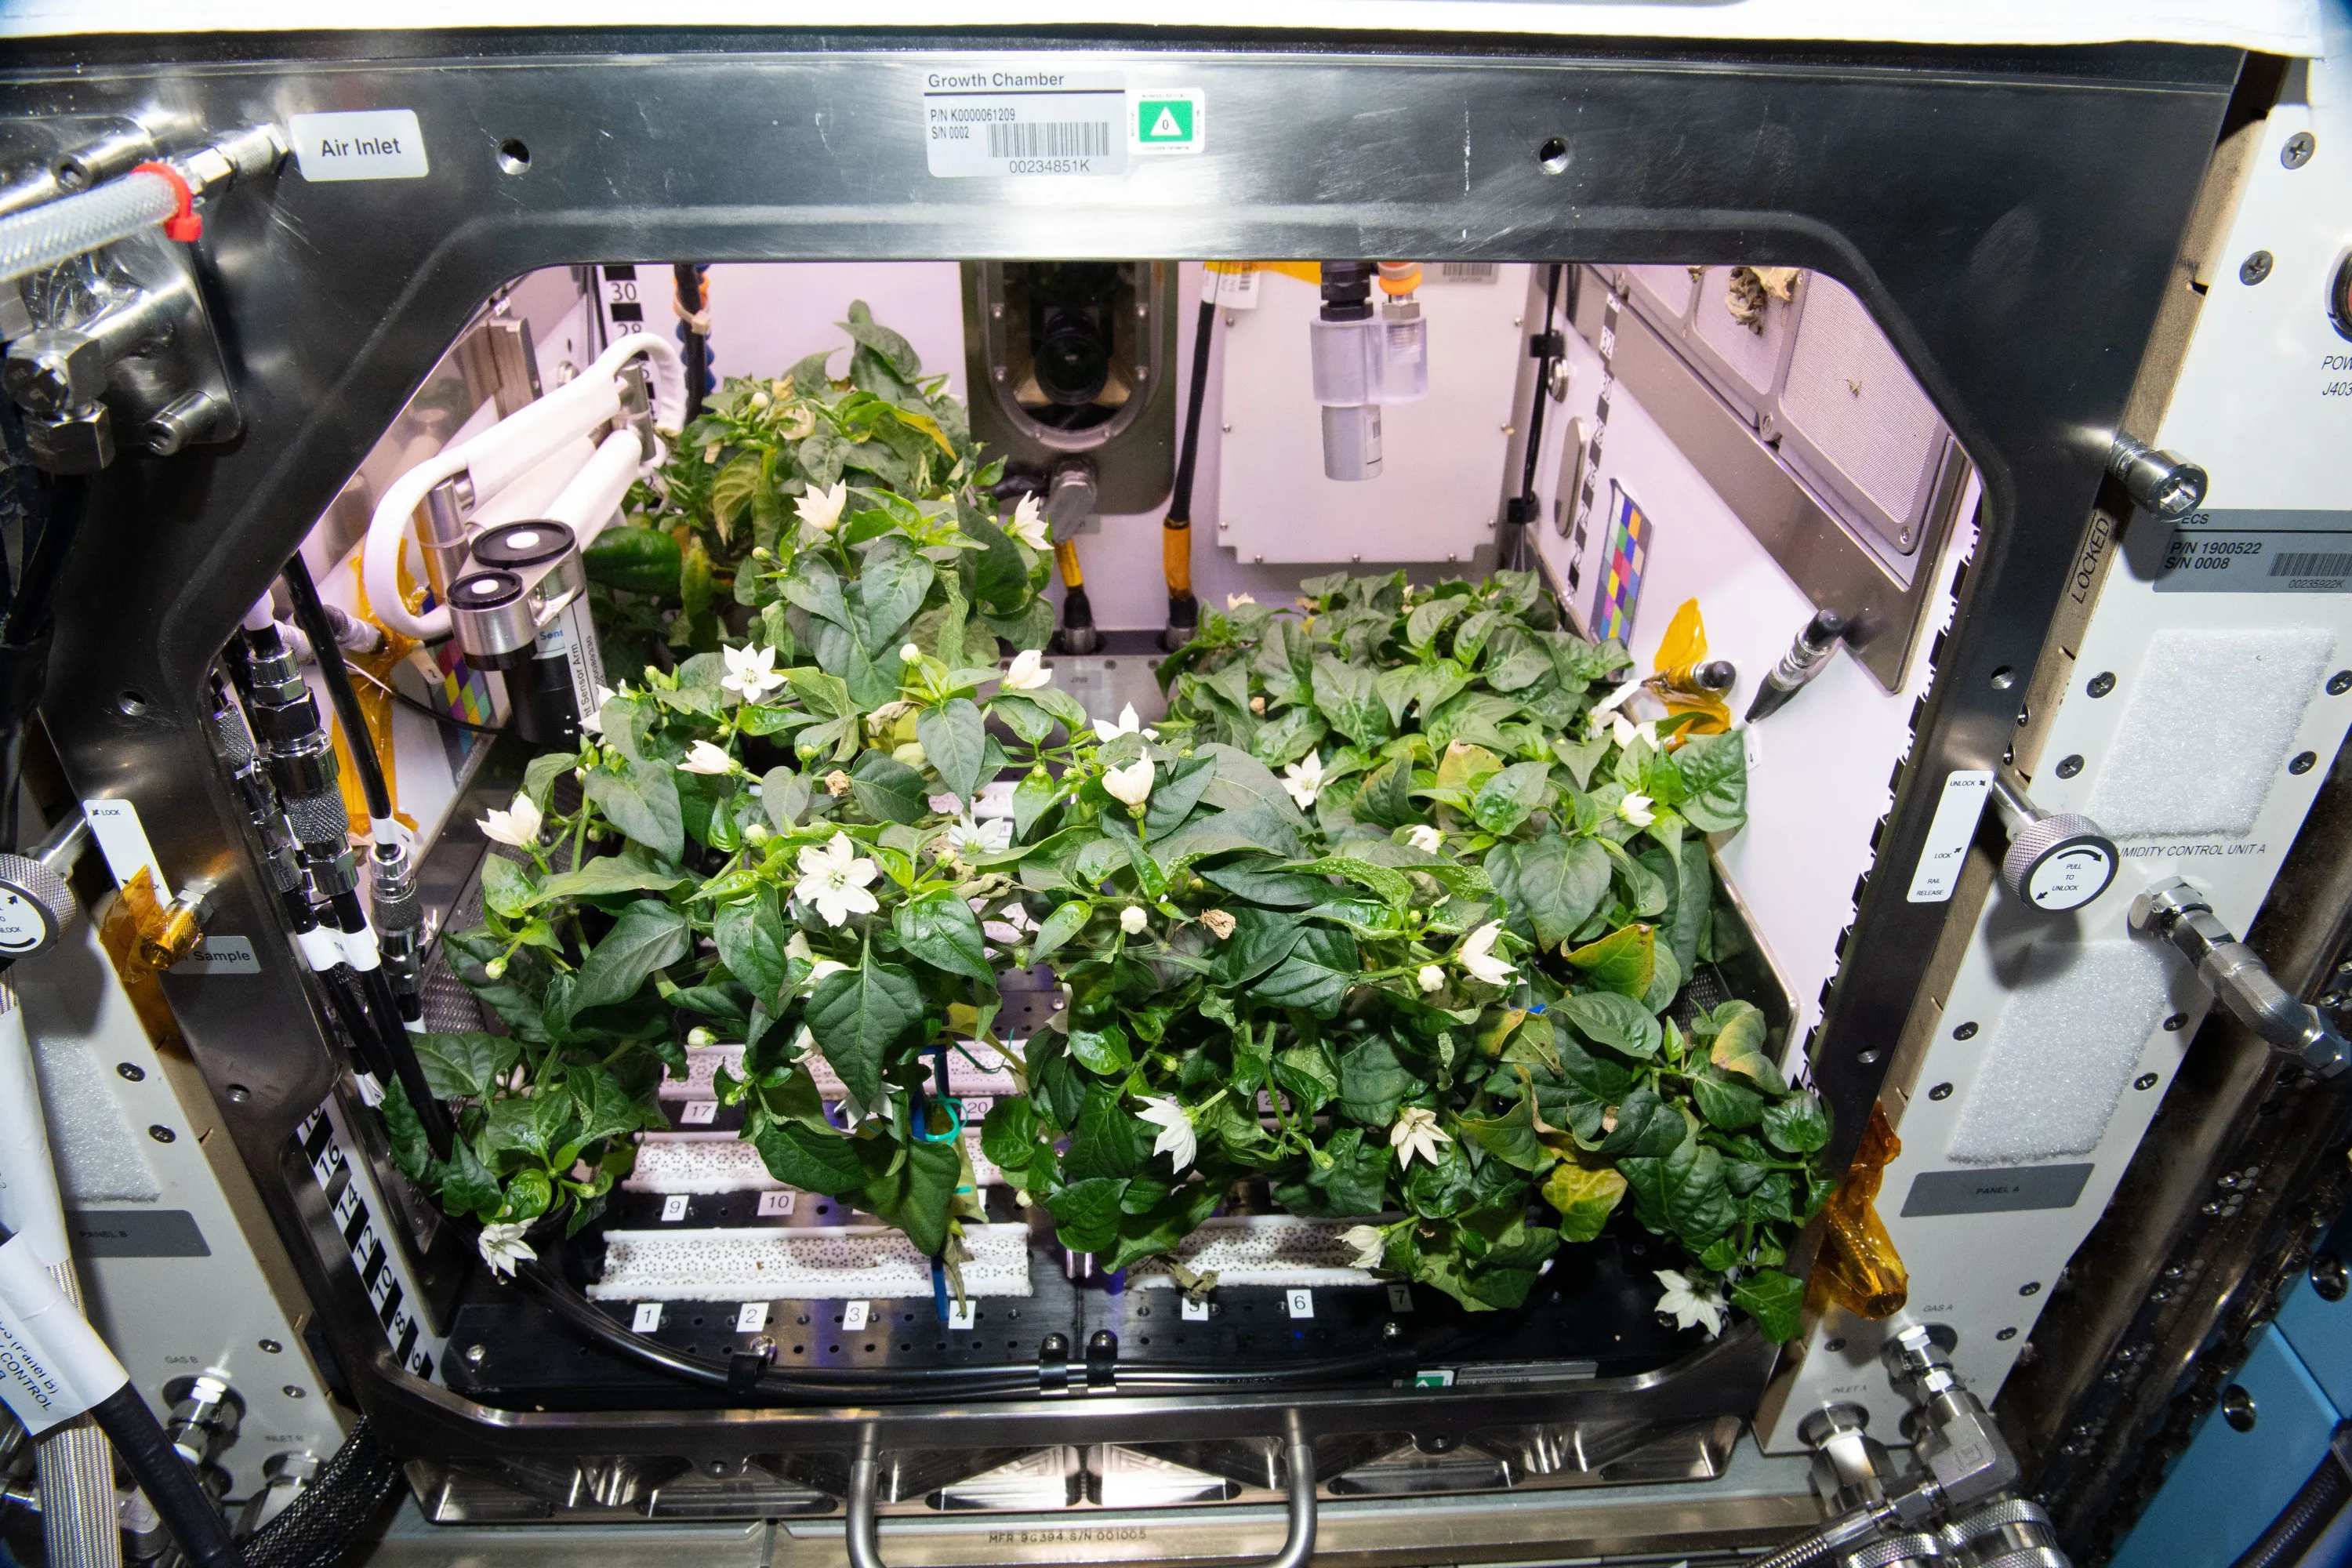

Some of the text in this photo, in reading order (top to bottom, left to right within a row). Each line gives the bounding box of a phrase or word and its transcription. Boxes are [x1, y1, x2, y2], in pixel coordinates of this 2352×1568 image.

[928, 72, 1065, 87] Growth Chamber
[930, 107, 1016, 122] P/N K0000061209
[931, 125, 970, 140] S/N 0002
[321, 137, 401, 157] Air Inlet
[1009, 158, 1091, 173] 00234851K
[611, 282, 637, 301] 30
[2181, 514, 2209, 524] ECS
[2170, 542, 2263, 555] P/N 1900522
[2071, 517, 2110, 604] LOCKED
[2165, 557, 2230, 569] S/N 0008
[2288, 579, 2346, 589] 00235922K
[571, 643, 582, 665] Arm
[575, 668, 590, 706] Sensor
[2118, 844, 2267, 858] UMIDITY CONTROL UNIT A
[193, 950, 251, 964] Sample
[691, 1105, 712, 1118] 17
[967, 1101, 989, 1114] 20
[319, 1138, 340, 1178] 16
[338, 1181, 359, 1222] 14
[669, 1200, 681, 1214] 9
[768, 1195, 790, 1210] 10
[357, 1225, 378, 1263] 12
[374, 1265, 394, 1302] 10
[1294, 1295, 1307, 1310] 6
[1393, 1290, 1406, 1305] 7
[644, 1309, 653, 1324] 1
[745, 1308, 757, 1324] 2
[848, 1307, 861, 1322] 3
[394, 1310, 405, 1336] 8
[412, 1345, 423, 1371] 6
[0, 1351, 53, 1412] CONTROL
[989, 1534, 1014, 1544] MFR
[1070, 1531, 1091, 1541] S/N
